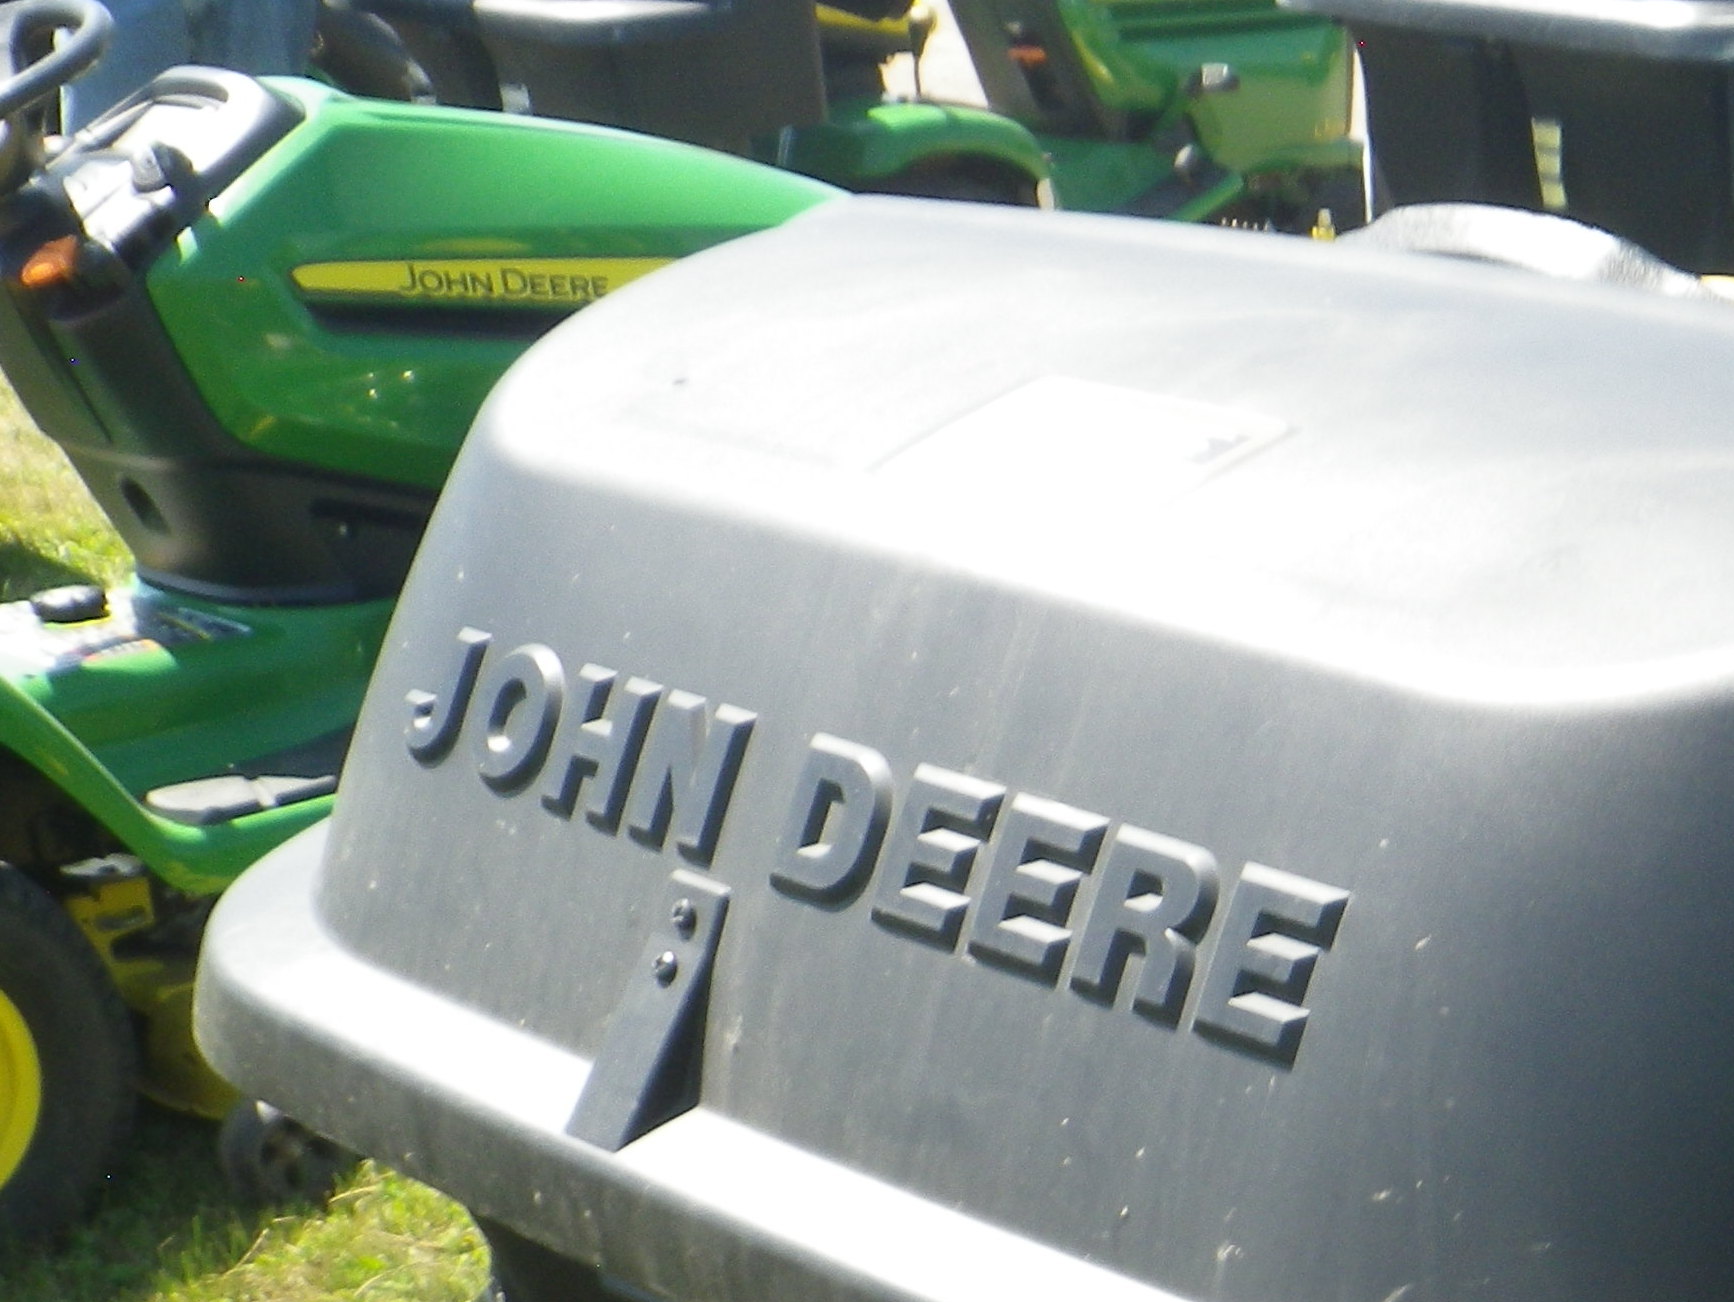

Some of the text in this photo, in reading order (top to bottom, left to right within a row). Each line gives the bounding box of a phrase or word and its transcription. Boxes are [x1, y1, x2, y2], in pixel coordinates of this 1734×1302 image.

[401, 263, 609, 298] JOHN DEERE
[404, 626, 1350, 1071] JOHN DEERE
